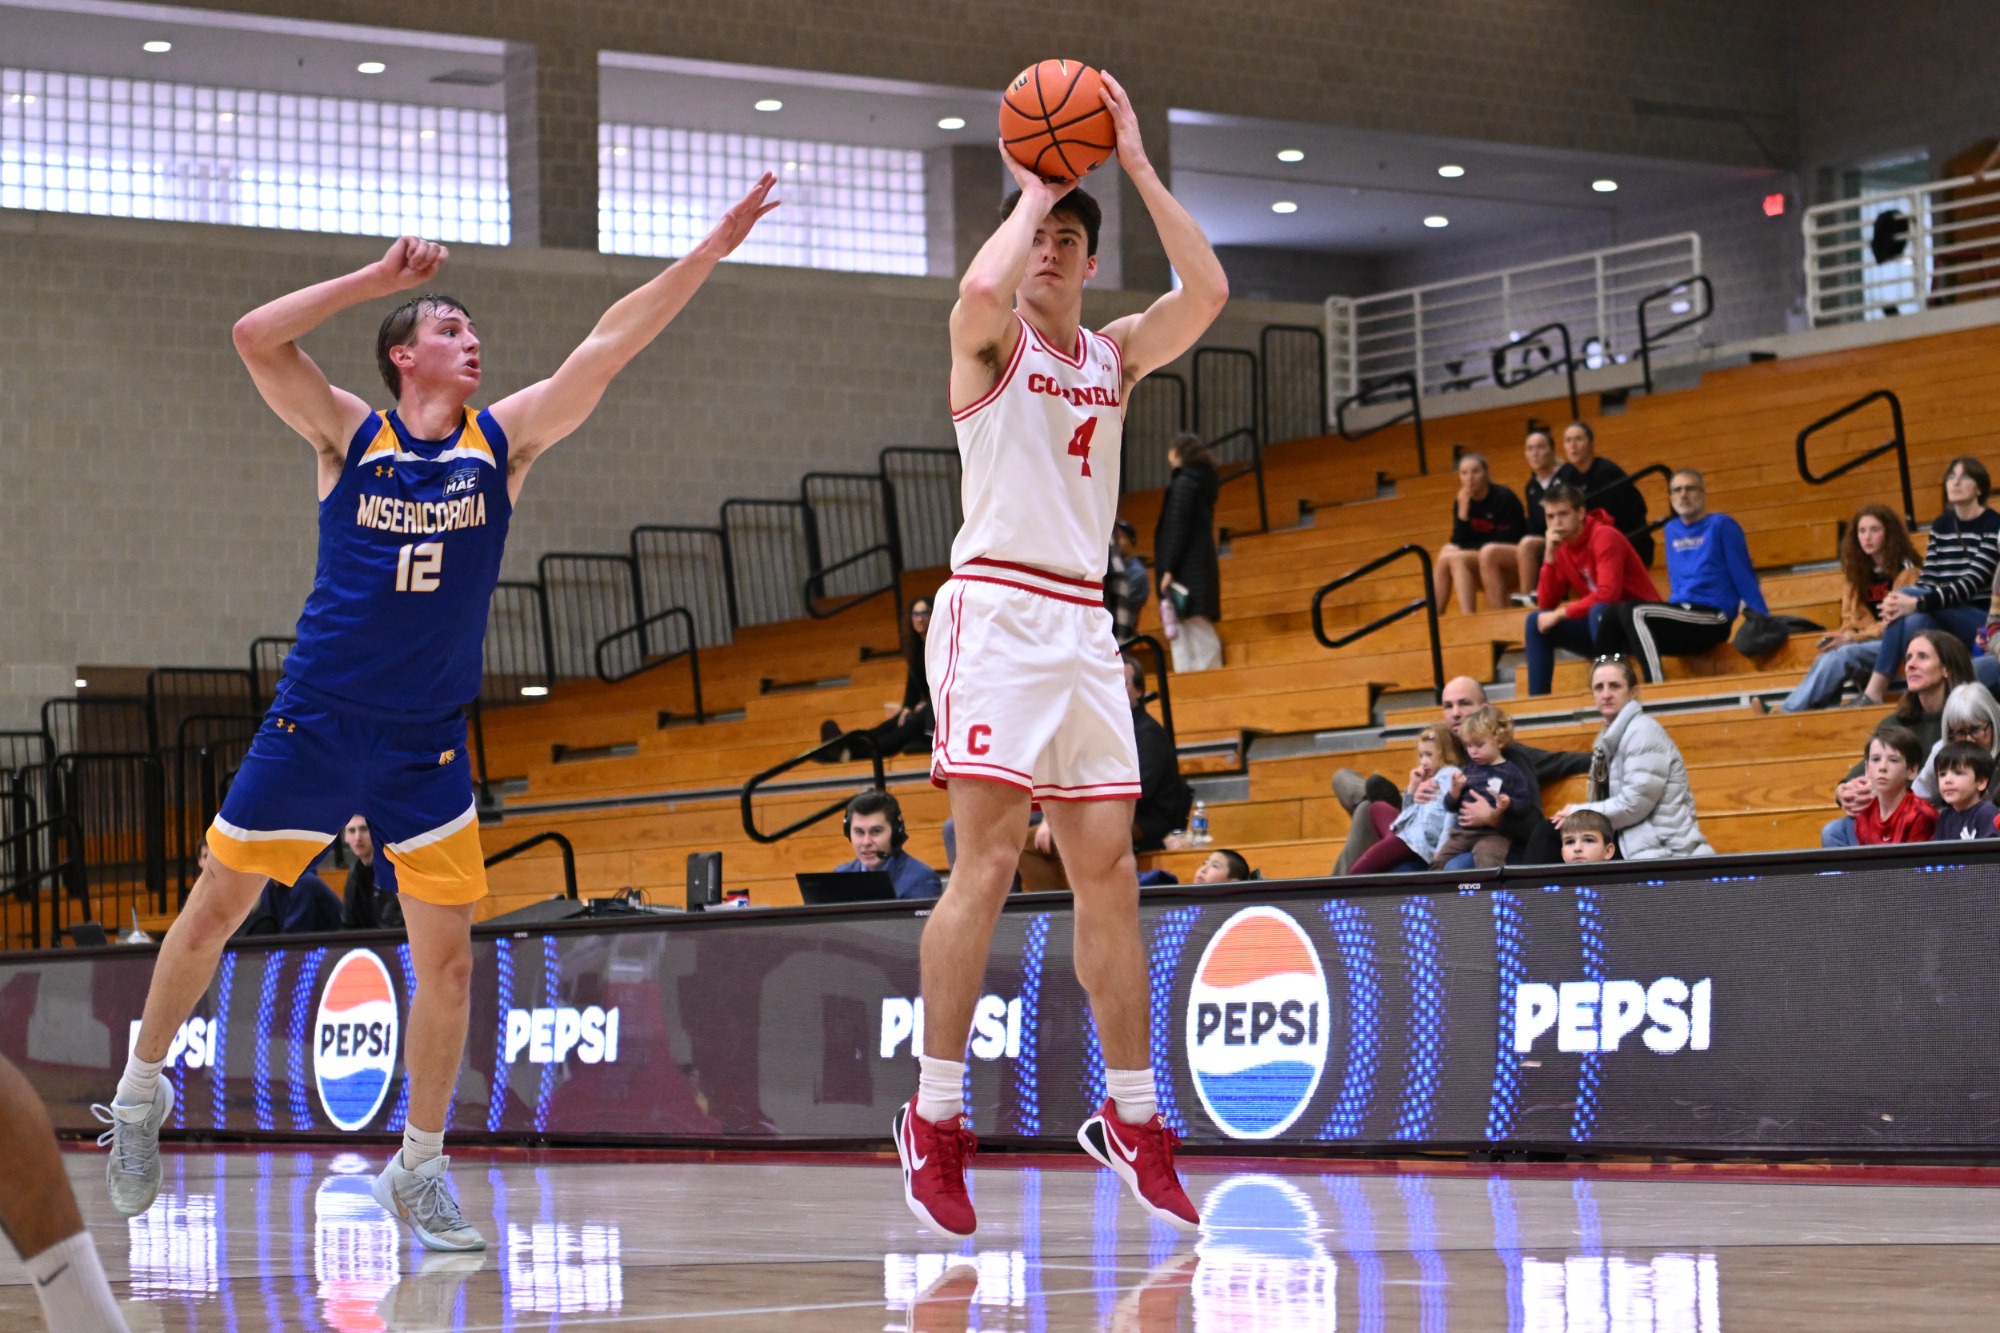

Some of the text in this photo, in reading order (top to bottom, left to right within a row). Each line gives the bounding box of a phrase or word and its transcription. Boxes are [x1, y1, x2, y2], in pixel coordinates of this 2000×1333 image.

[1067, 416, 1098, 477] 4
[446, 477, 476, 494] MAC
[357, 492, 486, 534] MISERICORDIA
[395, 542, 444, 592] 12
[967, 724, 992, 756] C
[320, 1022, 391, 1057] PEPSI
[505, 1005, 619, 1064] PEPSI
[880, 994, 1022, 1058] PSI
[1197, 999, 1319, 1046] PEPSI
[1514, 977, 1711, 1054] PEPSI
